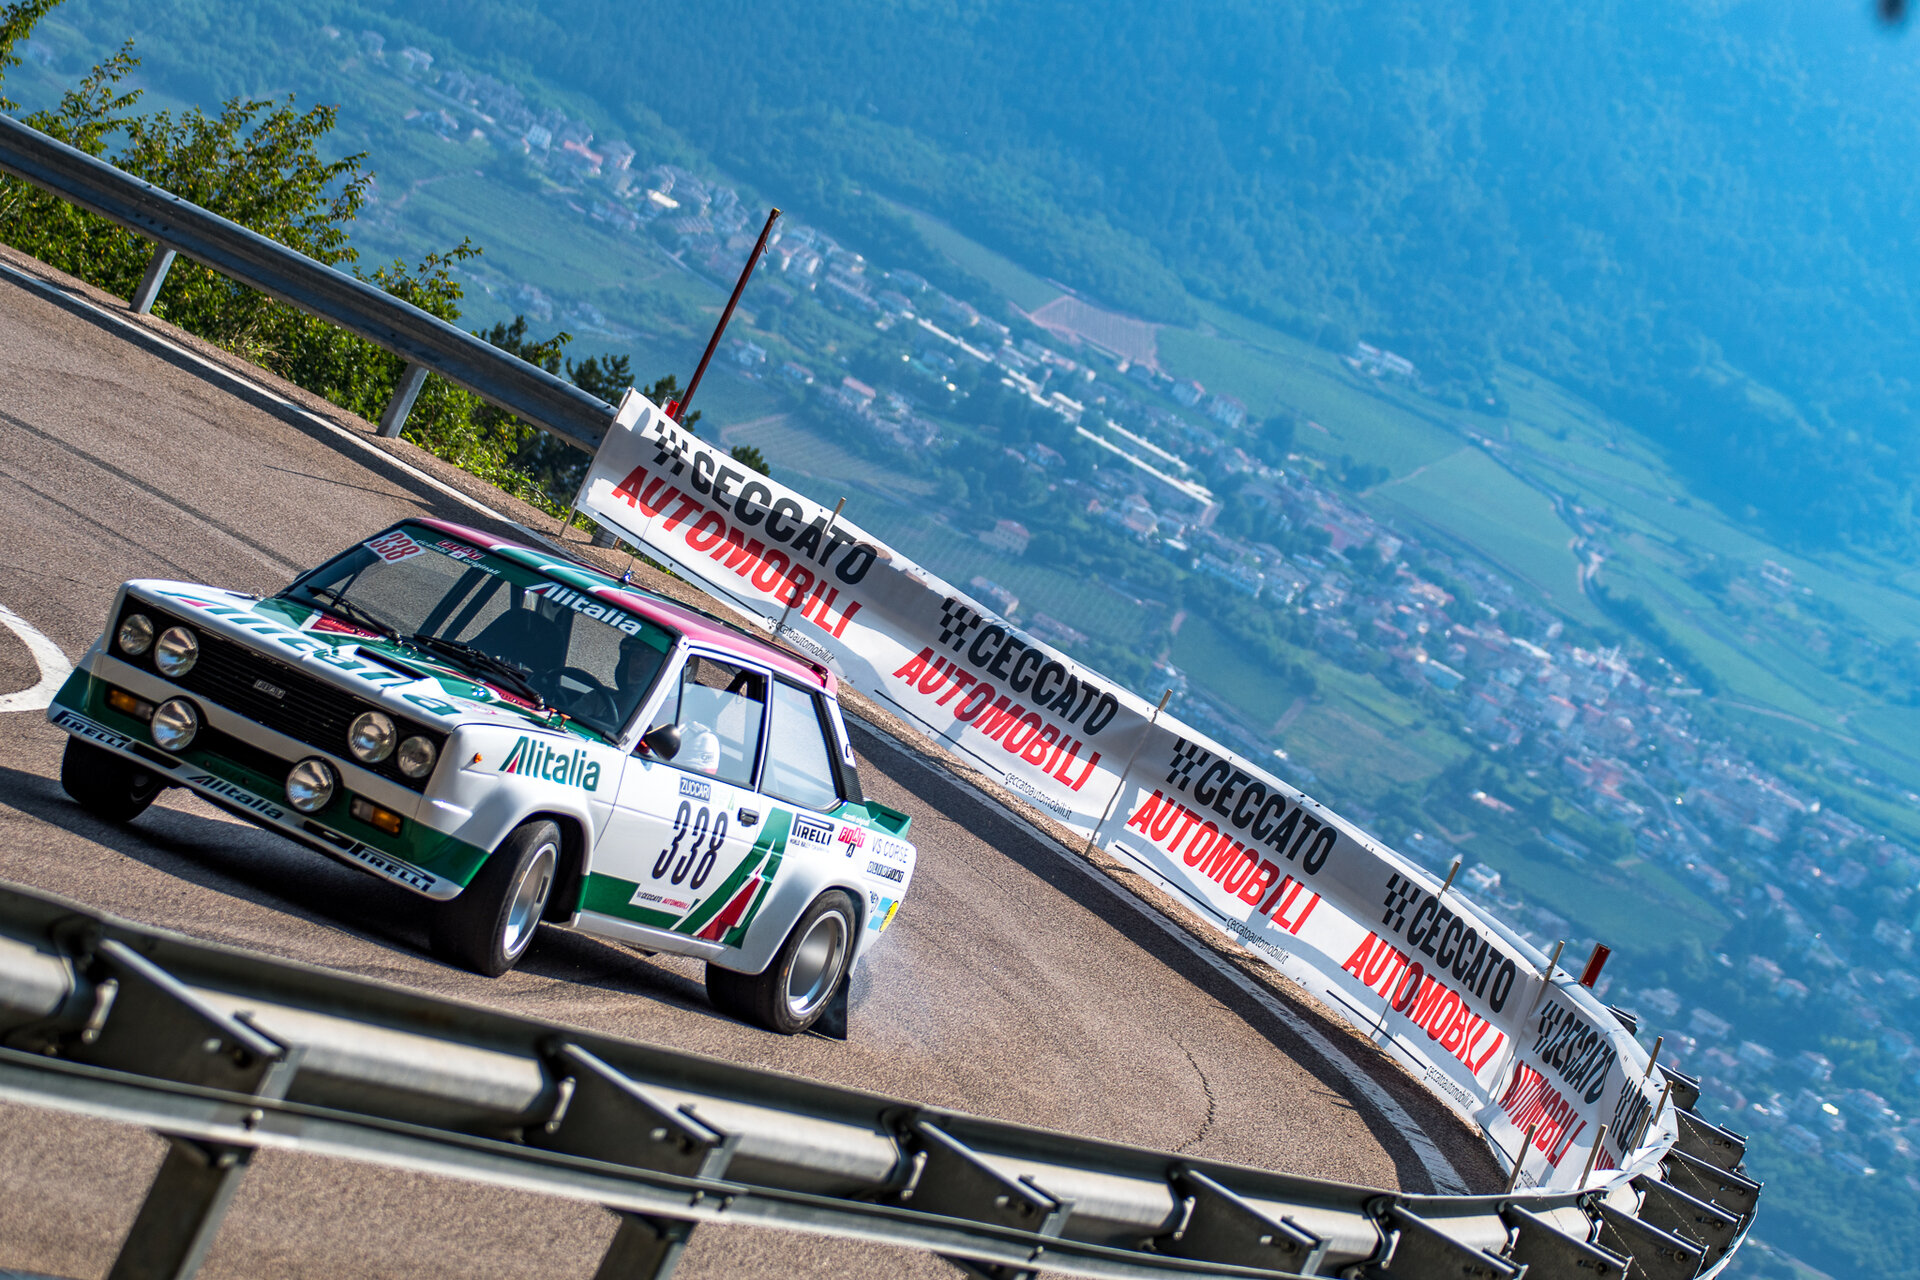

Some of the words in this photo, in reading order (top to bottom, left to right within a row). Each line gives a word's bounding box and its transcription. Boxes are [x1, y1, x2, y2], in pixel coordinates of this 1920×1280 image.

[690, 450, 878, 585] CECCATO
[369, 532, 421, 561] 338
[611, 465, 863, 639] AUTOMOBILI
[524, 582, 642, 635] Alitalia
[767, 616, 834, 664] ceccatoautomobili.it
[255, 679, 287, 699] FIAT
[967, 624, 1119, 736] CECCATO
[52, 710, 131, 749] PIRELLI
[892, 646, 1102, 792] AUTOMOBILI
[499, 736, 601, 792] Alitalia
[680, 779, 710, 801] ZUCCARI
[187, 775, 285, 820] Alitalia
[1005, 773, 1073, 820] ceccatoautomobili.it
[1193, 759, 1338, 875] CECCATO
[651, 800, 729, 890] 338
[791, 813, 835, 846] PIRELLI
[838, 827, 867, 848] FIAT
[348, 842, 437, 892] PIRELLI
[1127, 789, 1321, 935] AUTOMOBILI
[1226, 917, 1289, 965] ceccatoautomobili.it
[1407, 895, 1517, 1013] CECCATO
[1341, 930, 1504, 1077] AUTOMOBILI
[1541, 1011, 1617, 1104] CECCATO
